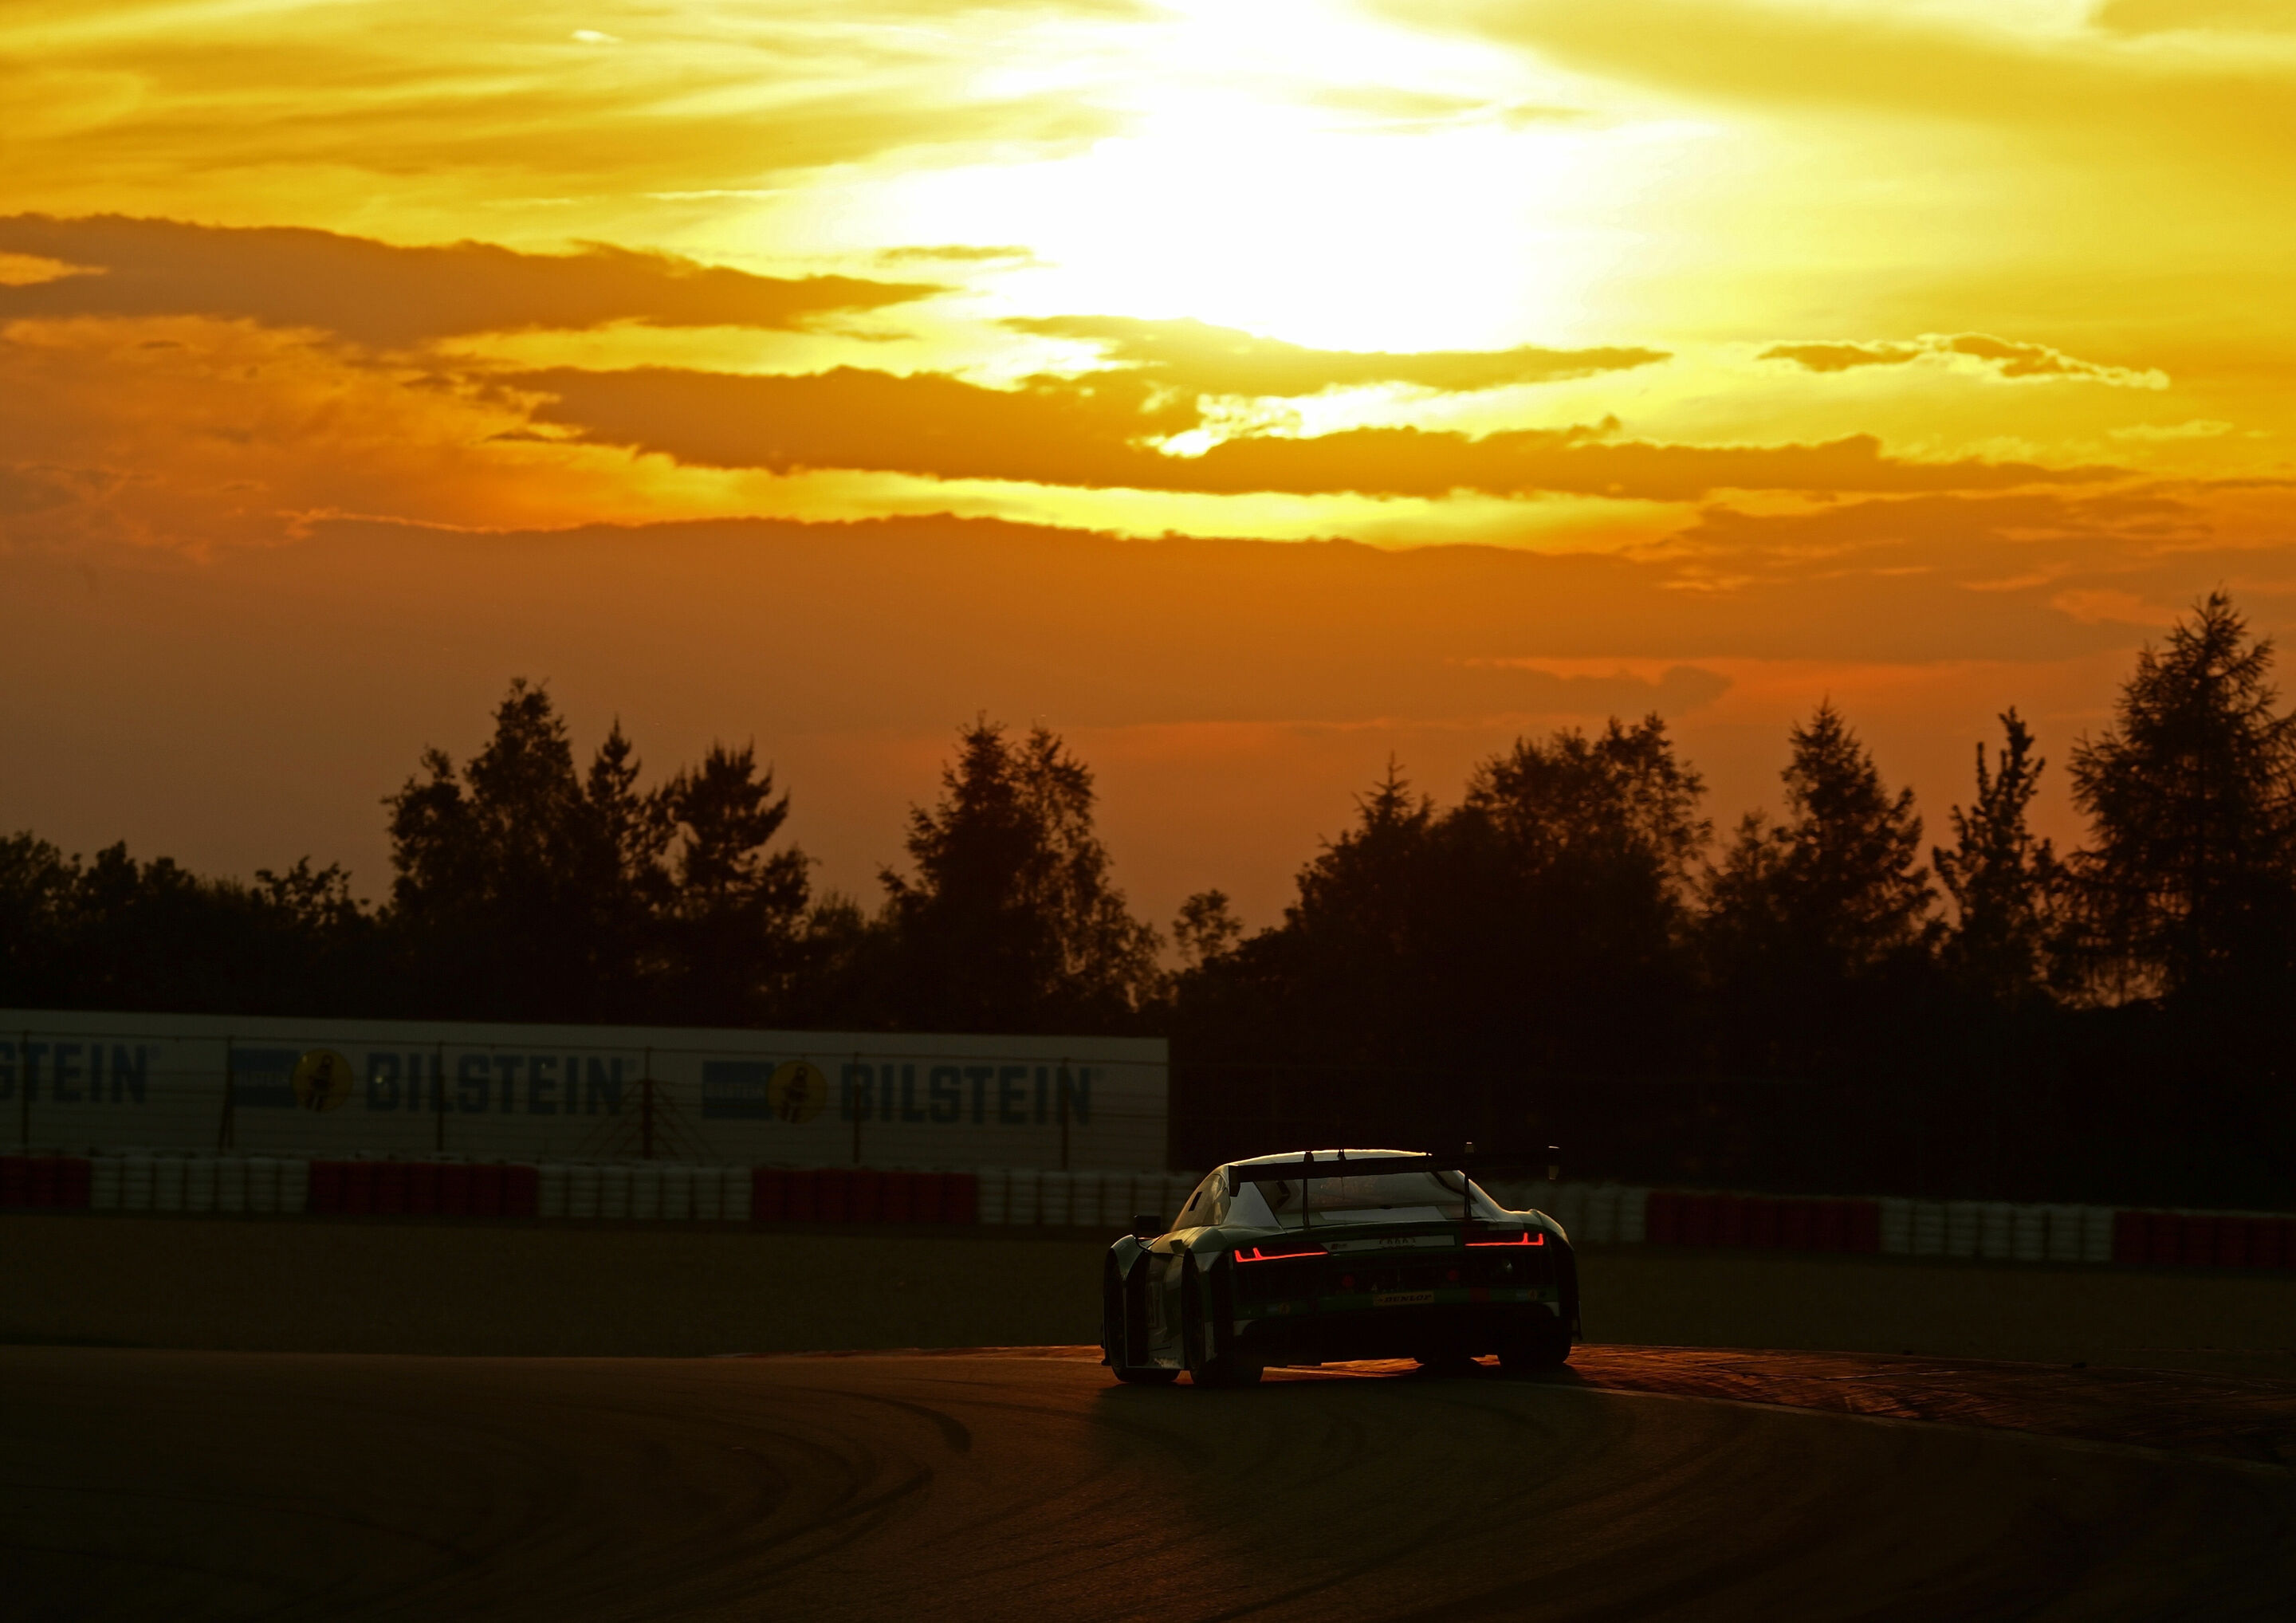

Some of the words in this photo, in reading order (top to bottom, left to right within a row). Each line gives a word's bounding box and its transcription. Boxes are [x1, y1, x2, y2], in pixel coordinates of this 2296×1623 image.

[367, 1053, 623, 1115] BILSTEIN
[841, 1063, 1091, 1125] BILSTEIN
[1384, 1294, 1432, 1303] DUNLOP
